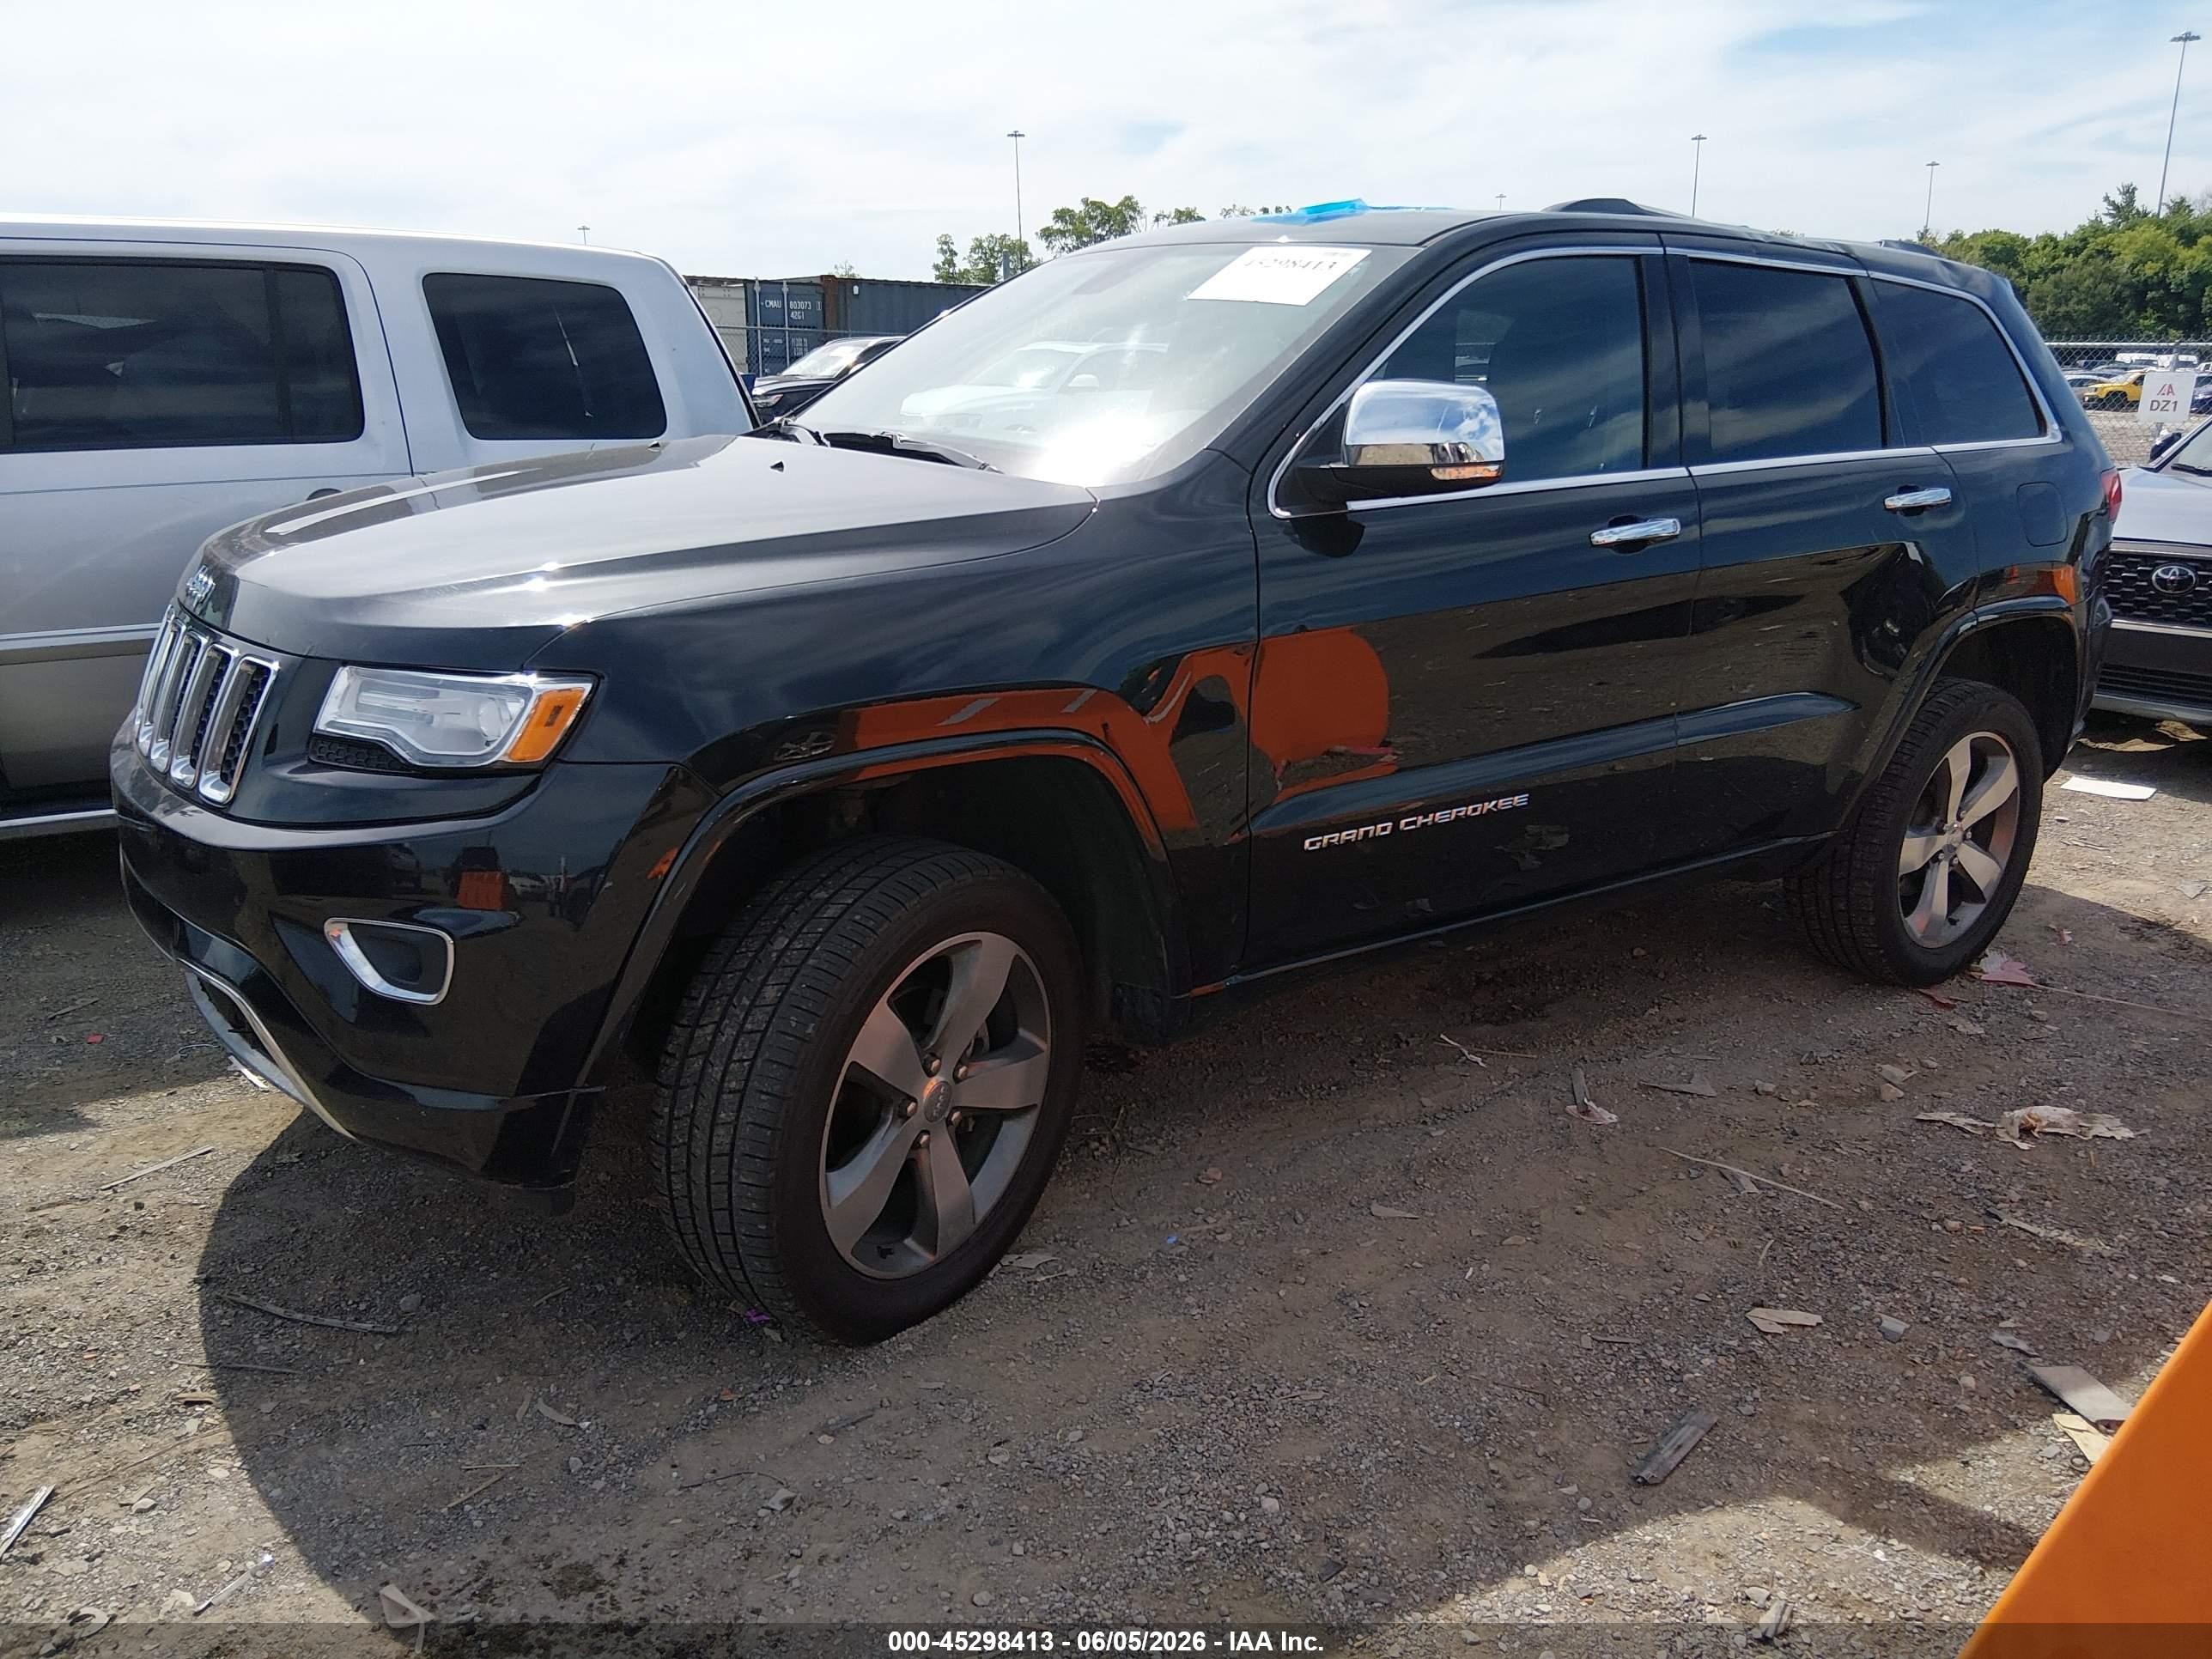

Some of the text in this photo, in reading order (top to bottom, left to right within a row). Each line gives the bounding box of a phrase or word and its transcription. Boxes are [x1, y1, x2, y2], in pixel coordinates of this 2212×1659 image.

[764, 299, 782, 309] CMAU
[789, 301, 811, 310] 803073
[790, 311, 805, 320] 42G1
[2149, 399, 2178, 412] DZ1
[1303, 793, 1529, 852] GRAND CHEROKEE
